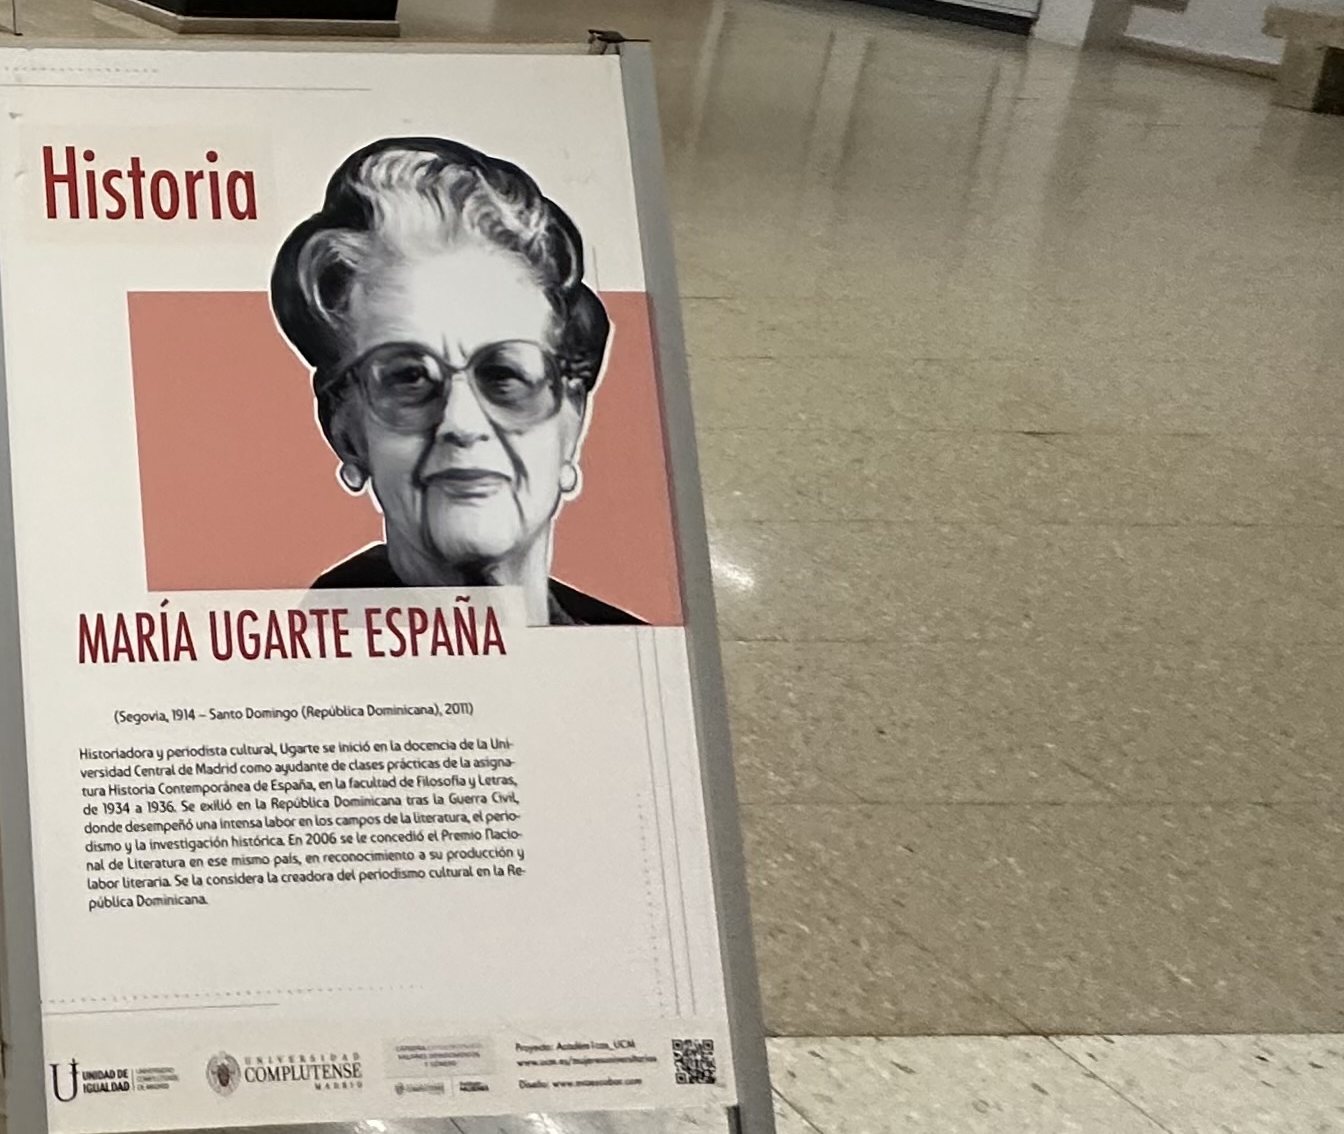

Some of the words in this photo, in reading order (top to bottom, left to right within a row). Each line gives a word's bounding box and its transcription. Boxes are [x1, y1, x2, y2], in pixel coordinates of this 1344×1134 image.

[43, 146, 256, 219] Historia
[80, 600, 196, 662] MARÍA
[210, 609, 350, 660] UGARTE
[366, 597, 505, 656] ESPAÑA
[113, 709, 170, 726] (Segovia,
[170, 707, 196, 721] 1914
[208, 707, 244, 721] Santo
[244, 706, 299, 722] Domingo
[301, 704, 365, 722] (República
[366, 703, 443, 720] Dominicana),
[444, 701, 474, 717] 2011)
[78, 745, 155, 760] Historiadora
[155, 748, 164, 762] y
[165, 744, 228, 762] periodista
[228, 741, 278, 757] cultural,
[278, 741, 320, 759] Ugarte
[321, 743, 336, 754] se
[337, 739, 371, 753] inició
[372, 742, 388, 753] en
[388, 739, 402, 752] la
[402, 738, 457, 752] docencia
[458, 737, 475, 751] de
[475, 737, 488, 750] la
[489, 736, 514, 750] Uni-
[82, 802, 98, 816] de
[101, 801, 130, 815] 1934
[134, 803, 143, 814] a
[145, 799, 178, 814] 1936.
[179, 798, 196, 813] Se
[199, 797, 233, 812] exilió
[235, 800, 252, 811] en
[254, 797, 267, 811] la
[269, 795, 330, 813] República
[333, 794, 402, 808] Dominicana
[405, 795, 430, 806] tras
[431, 792, 445, 806] la
[447, 791, 488, 805] Guerra
[490, 790, 520, 805] Civil,
[88, 894, 134, 913] pública
[135, 893, 209, 907] Dominicana.
[82, 1069, 116, 1080] UNIDAD
[117, 1069, 129, 1079] DE
[244, 1063, 363, 1082] COMPLUTENSE
[83, 1081, 130, 1094] IGUALDAD
